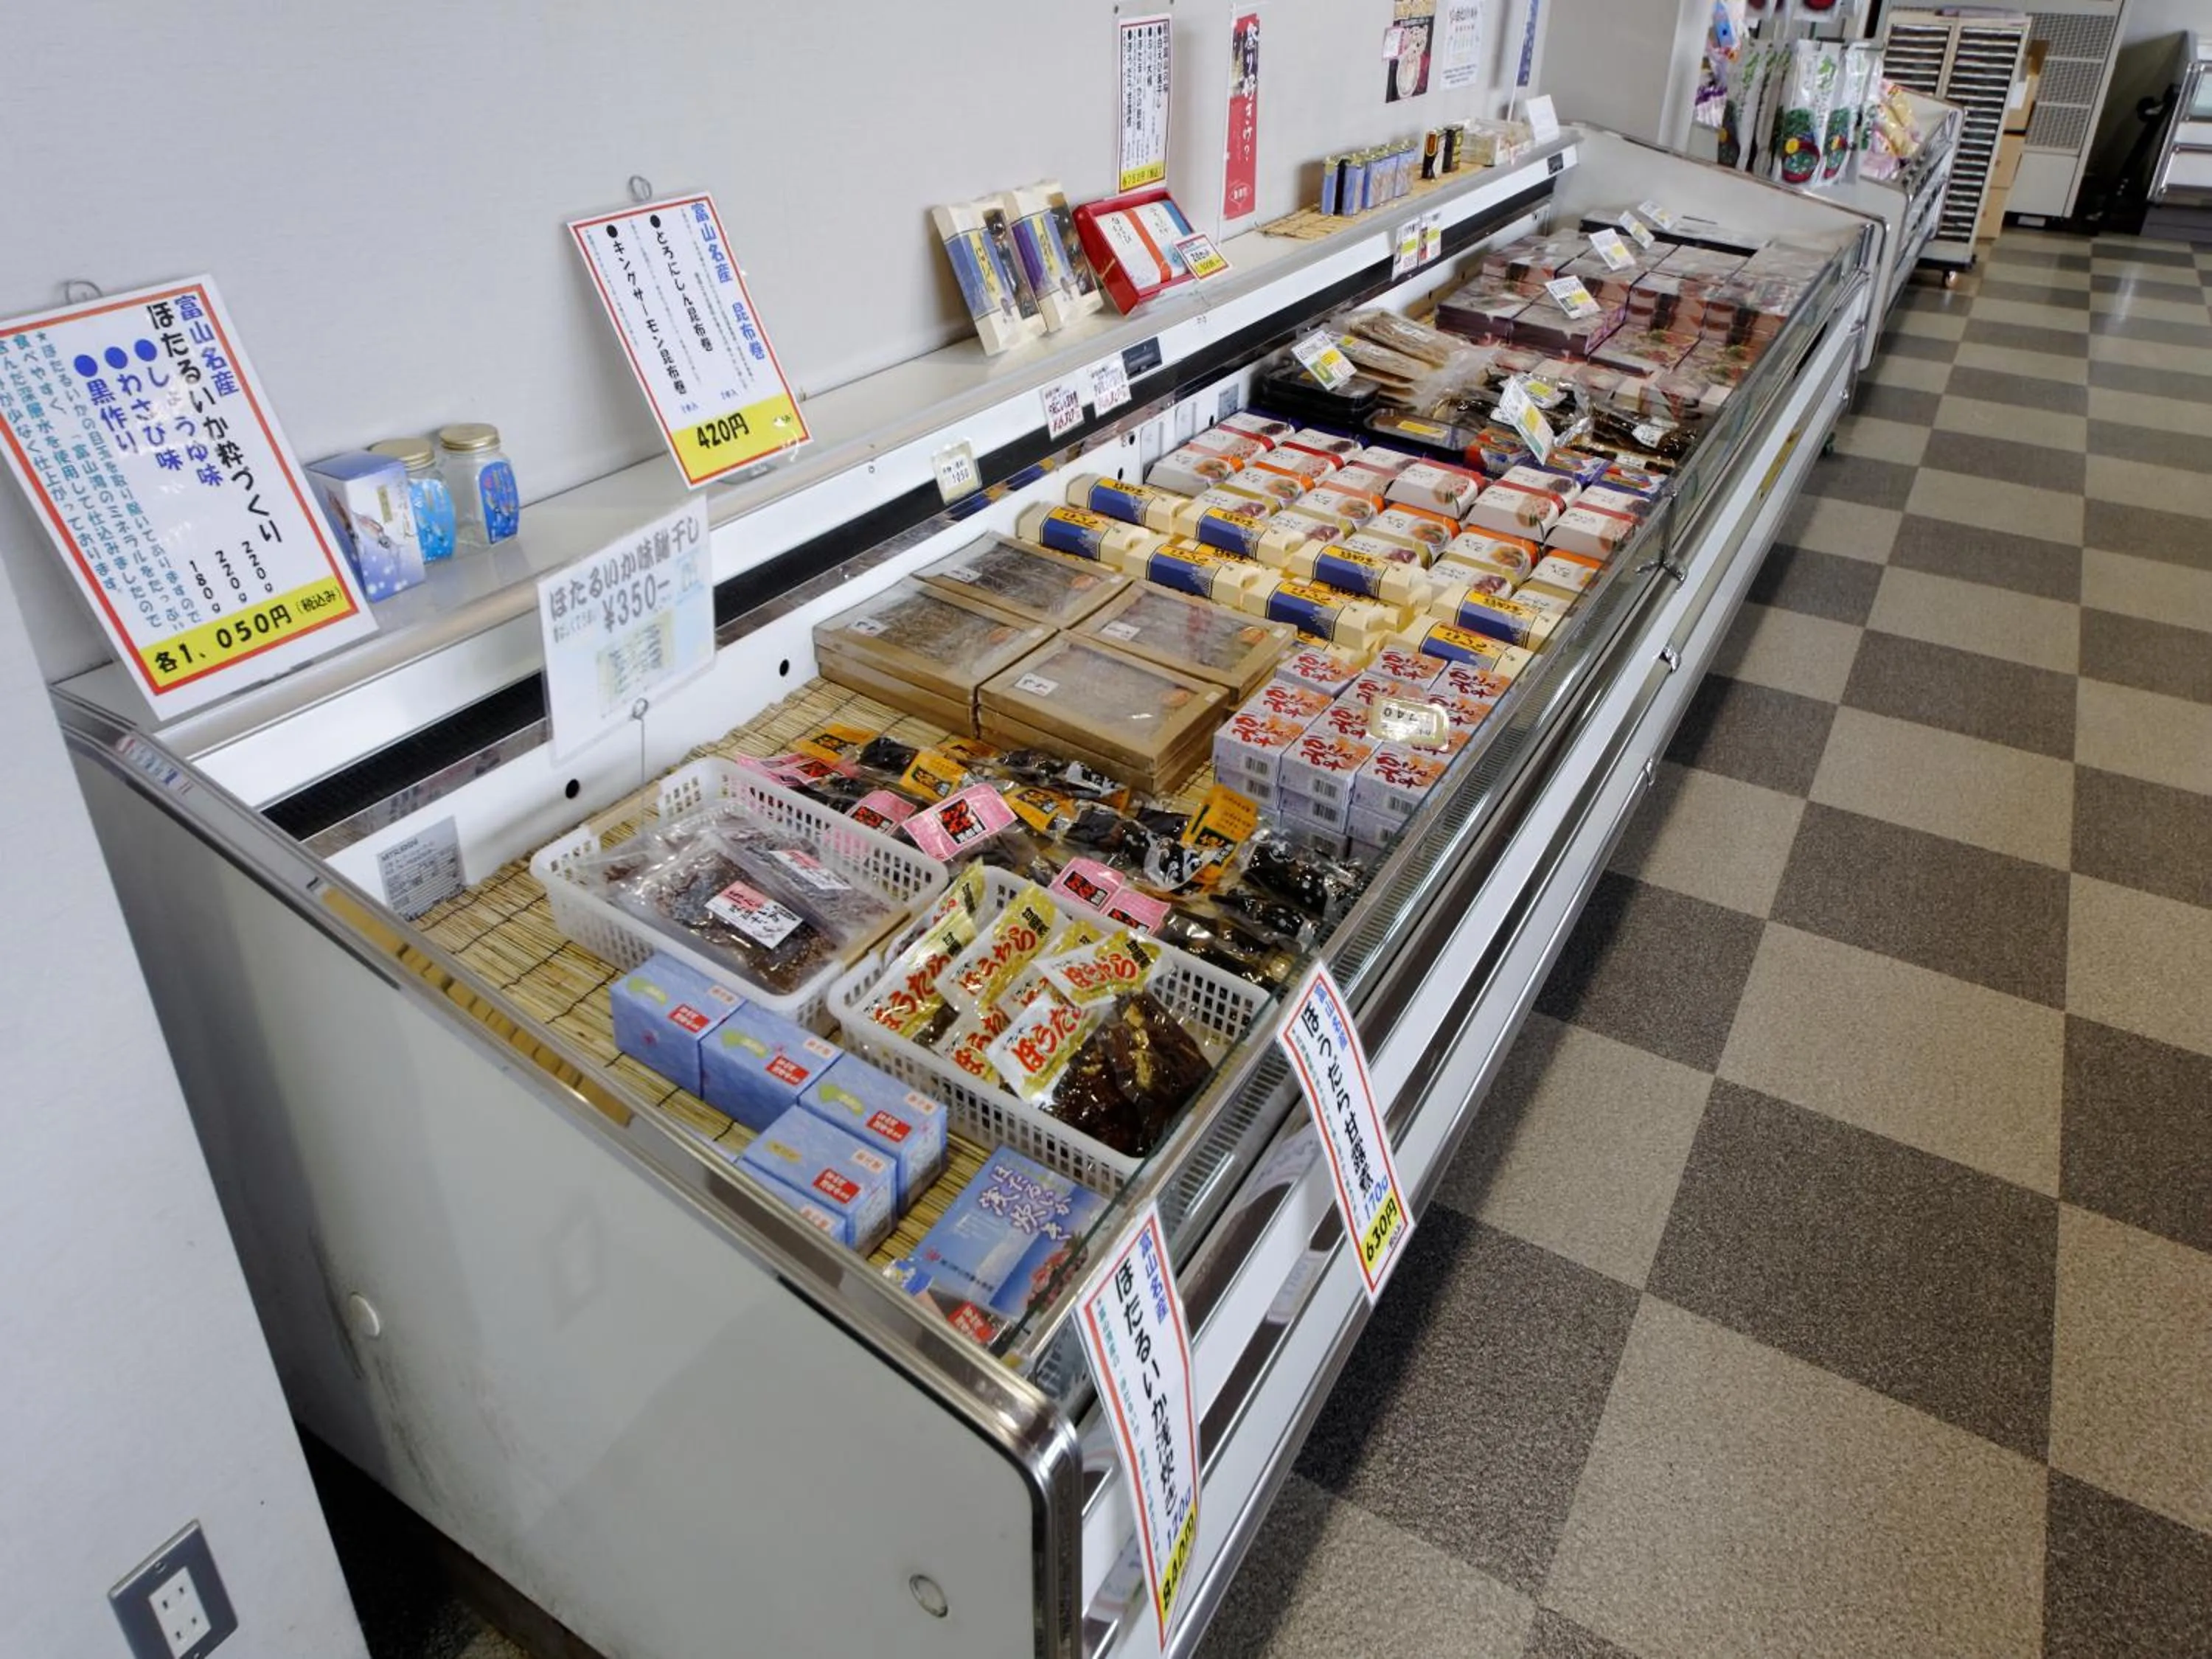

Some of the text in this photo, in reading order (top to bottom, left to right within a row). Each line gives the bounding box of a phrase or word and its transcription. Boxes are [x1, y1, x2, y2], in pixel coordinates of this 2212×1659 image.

[612, 241, 686, 396] キングサーモン昆布巻
[655, 232, 714, 353] とろにしん昆布巻
[691, 202, 734, 284] 富山名産
[733, 302, 765, 361] 昆布巻
[174, 295, 240, 397] 富山名産
[86, 380, 139, 455] 黒作り
[116, 373, 184, 472] わさび味
[146, 303, 282, 544] ほたるいか粋づくり
[695, 412, 750, 450] 420円
[1138, 1230, 1171, 1326] 富山名産
[1365, 1196, 1399, 1264] 630円
[1114, 1255, 1178, 1518] ほたるいか浅炊き
